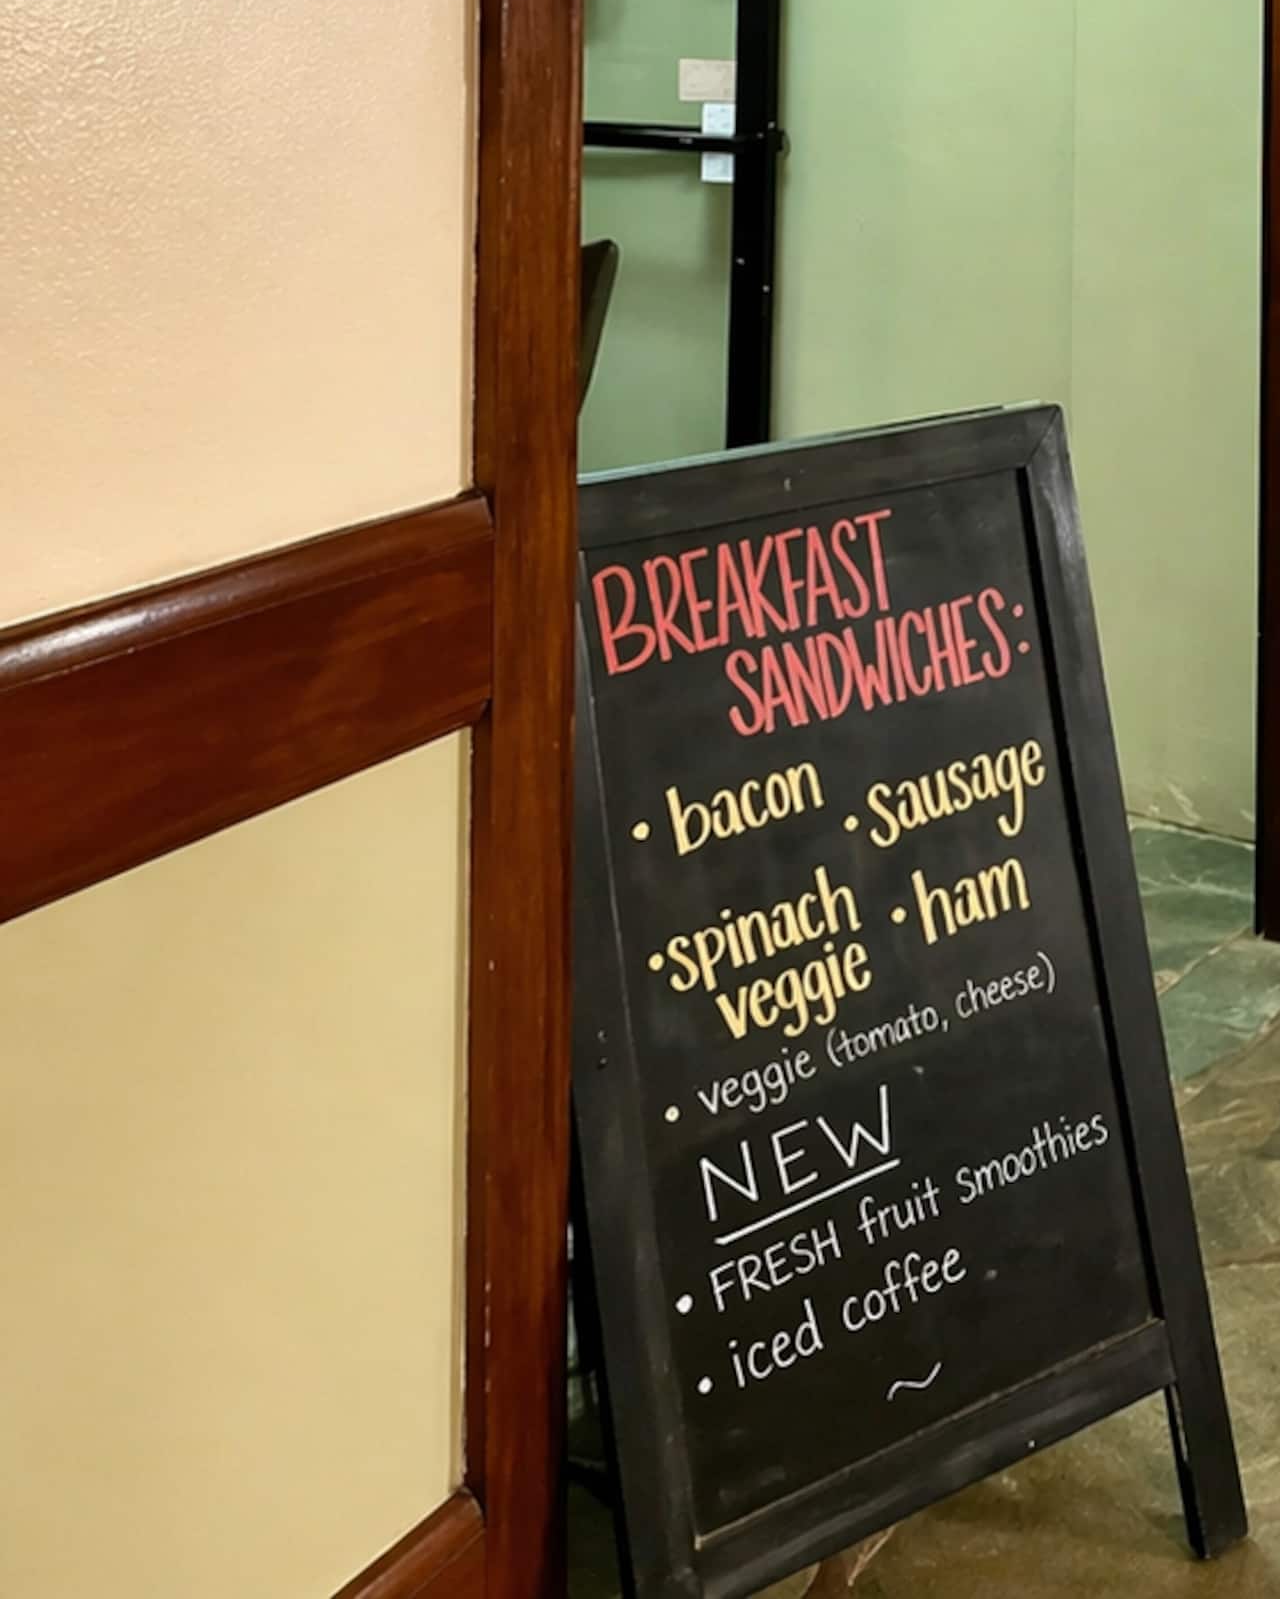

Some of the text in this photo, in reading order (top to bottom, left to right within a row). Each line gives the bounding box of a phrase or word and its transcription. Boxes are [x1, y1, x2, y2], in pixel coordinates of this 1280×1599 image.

[592, 508, 892, 676] BREAKFAST
[724, 587, 1030, 737] SANDWICHES:
[666, 762, 824, 856] bacon
[865, 738, 1047, 848] sausage
[665, 865, 861, 993] spinach
[912, 856, 1031, 944] ham
[698, 950, 1056, 1114] veggie (tomato, cheese)
[714, 940, 873, 1040] veggie
[699, 1085, 892, 1221] NEW
[710, 1113, 1109, 1312] FRESH fruit smoothies
[729, 1247, 967, 1388] iced coffee
